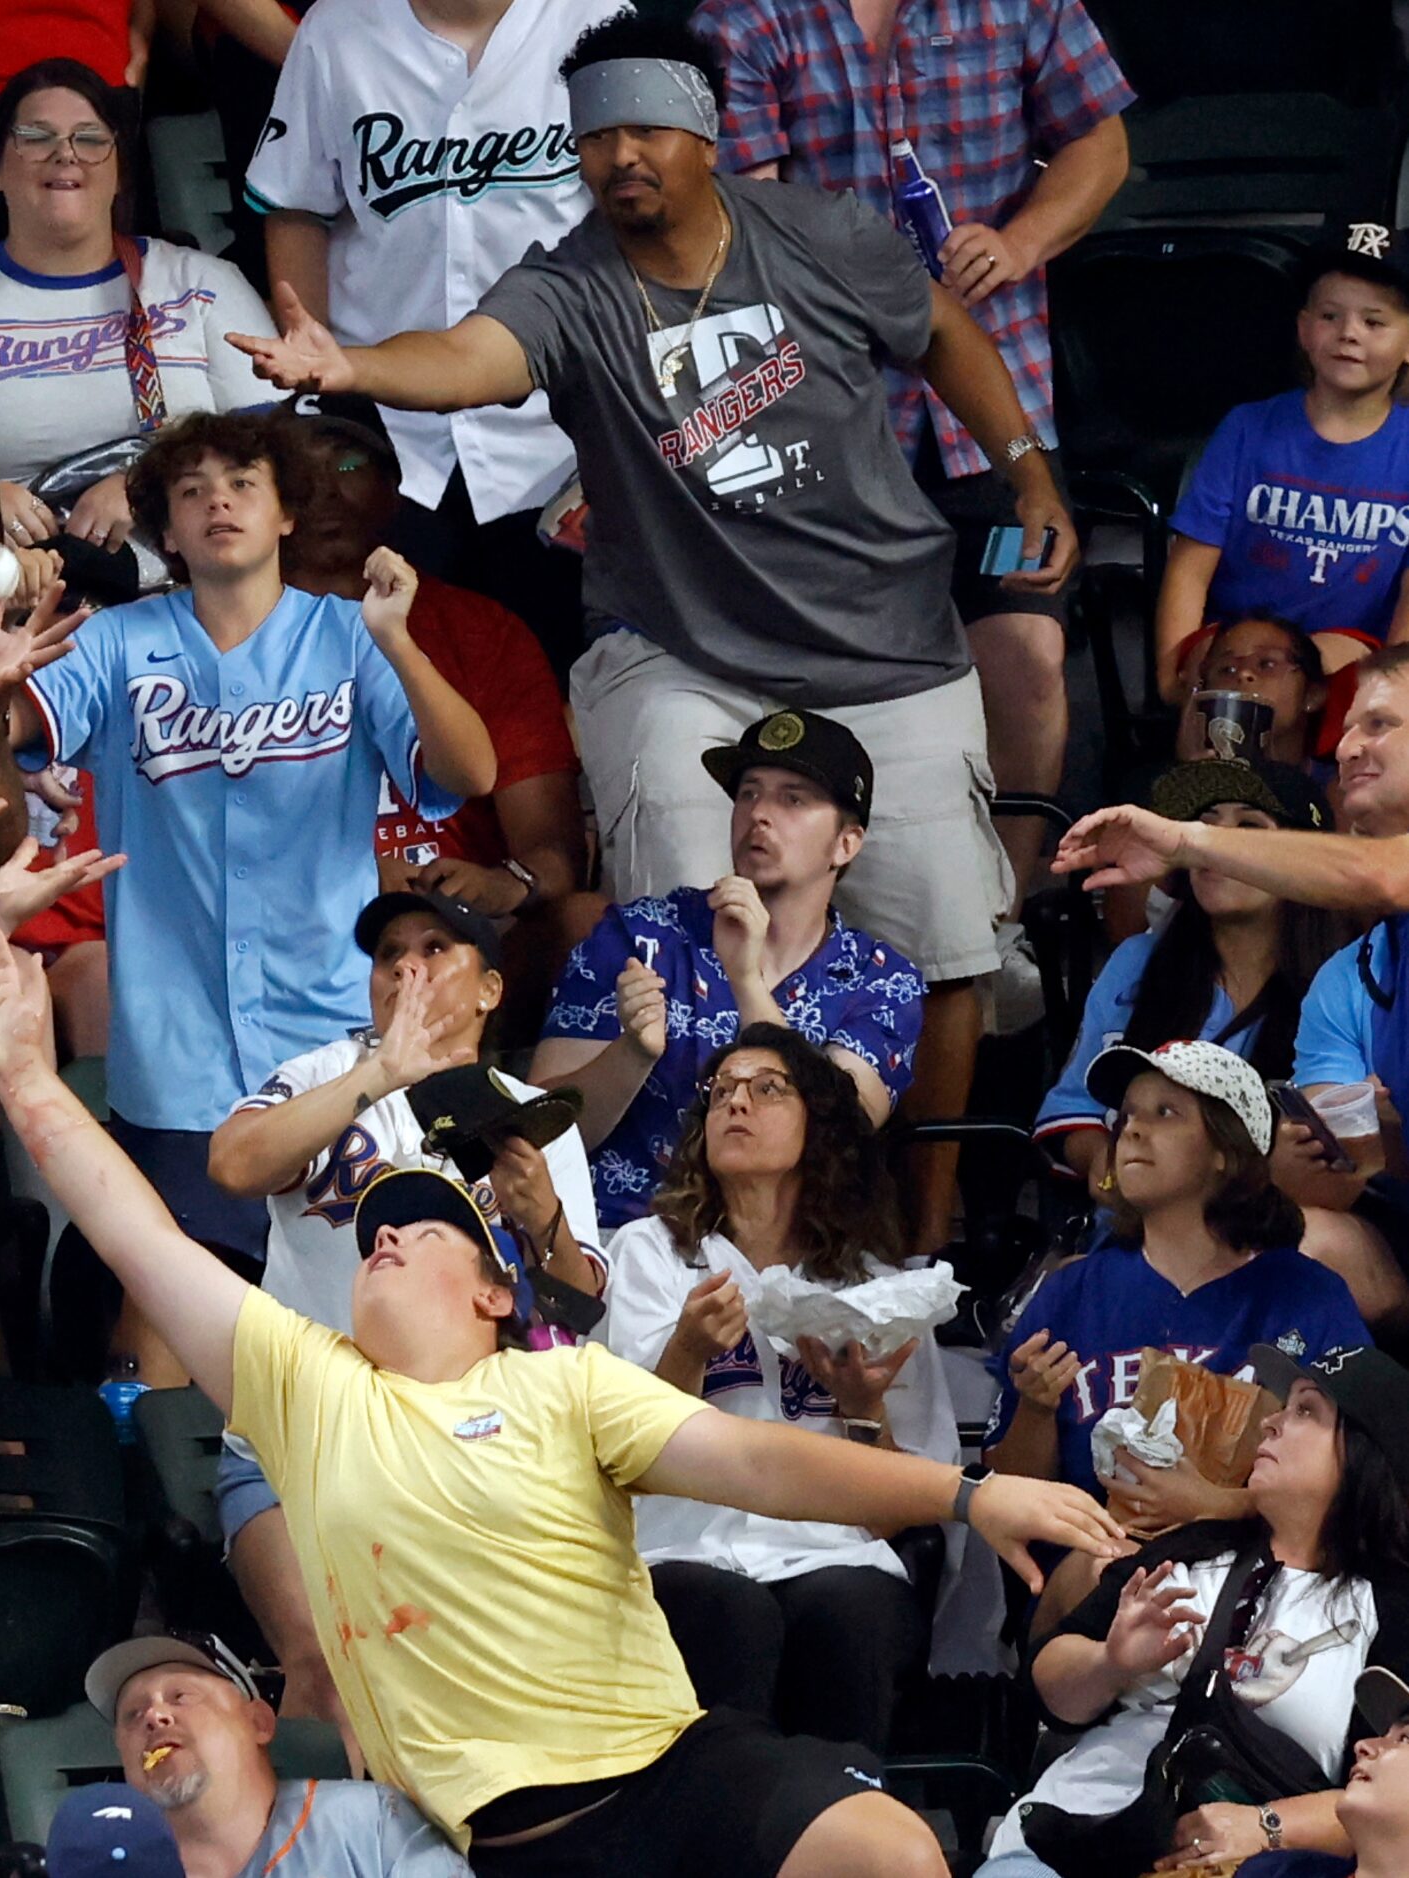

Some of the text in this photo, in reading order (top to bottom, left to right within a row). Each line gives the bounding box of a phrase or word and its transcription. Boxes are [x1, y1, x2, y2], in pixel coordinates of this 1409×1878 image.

[658, 341, 806, 470] RANGERS
[1246, 483, 1409, 548] CHAMPS
[1269, 528, 1315, 547] TEXAS
[1306, 545, 1340, 584] T
[126, 673, 357, 786] Rangers
[634, 934, 660, 971] T
